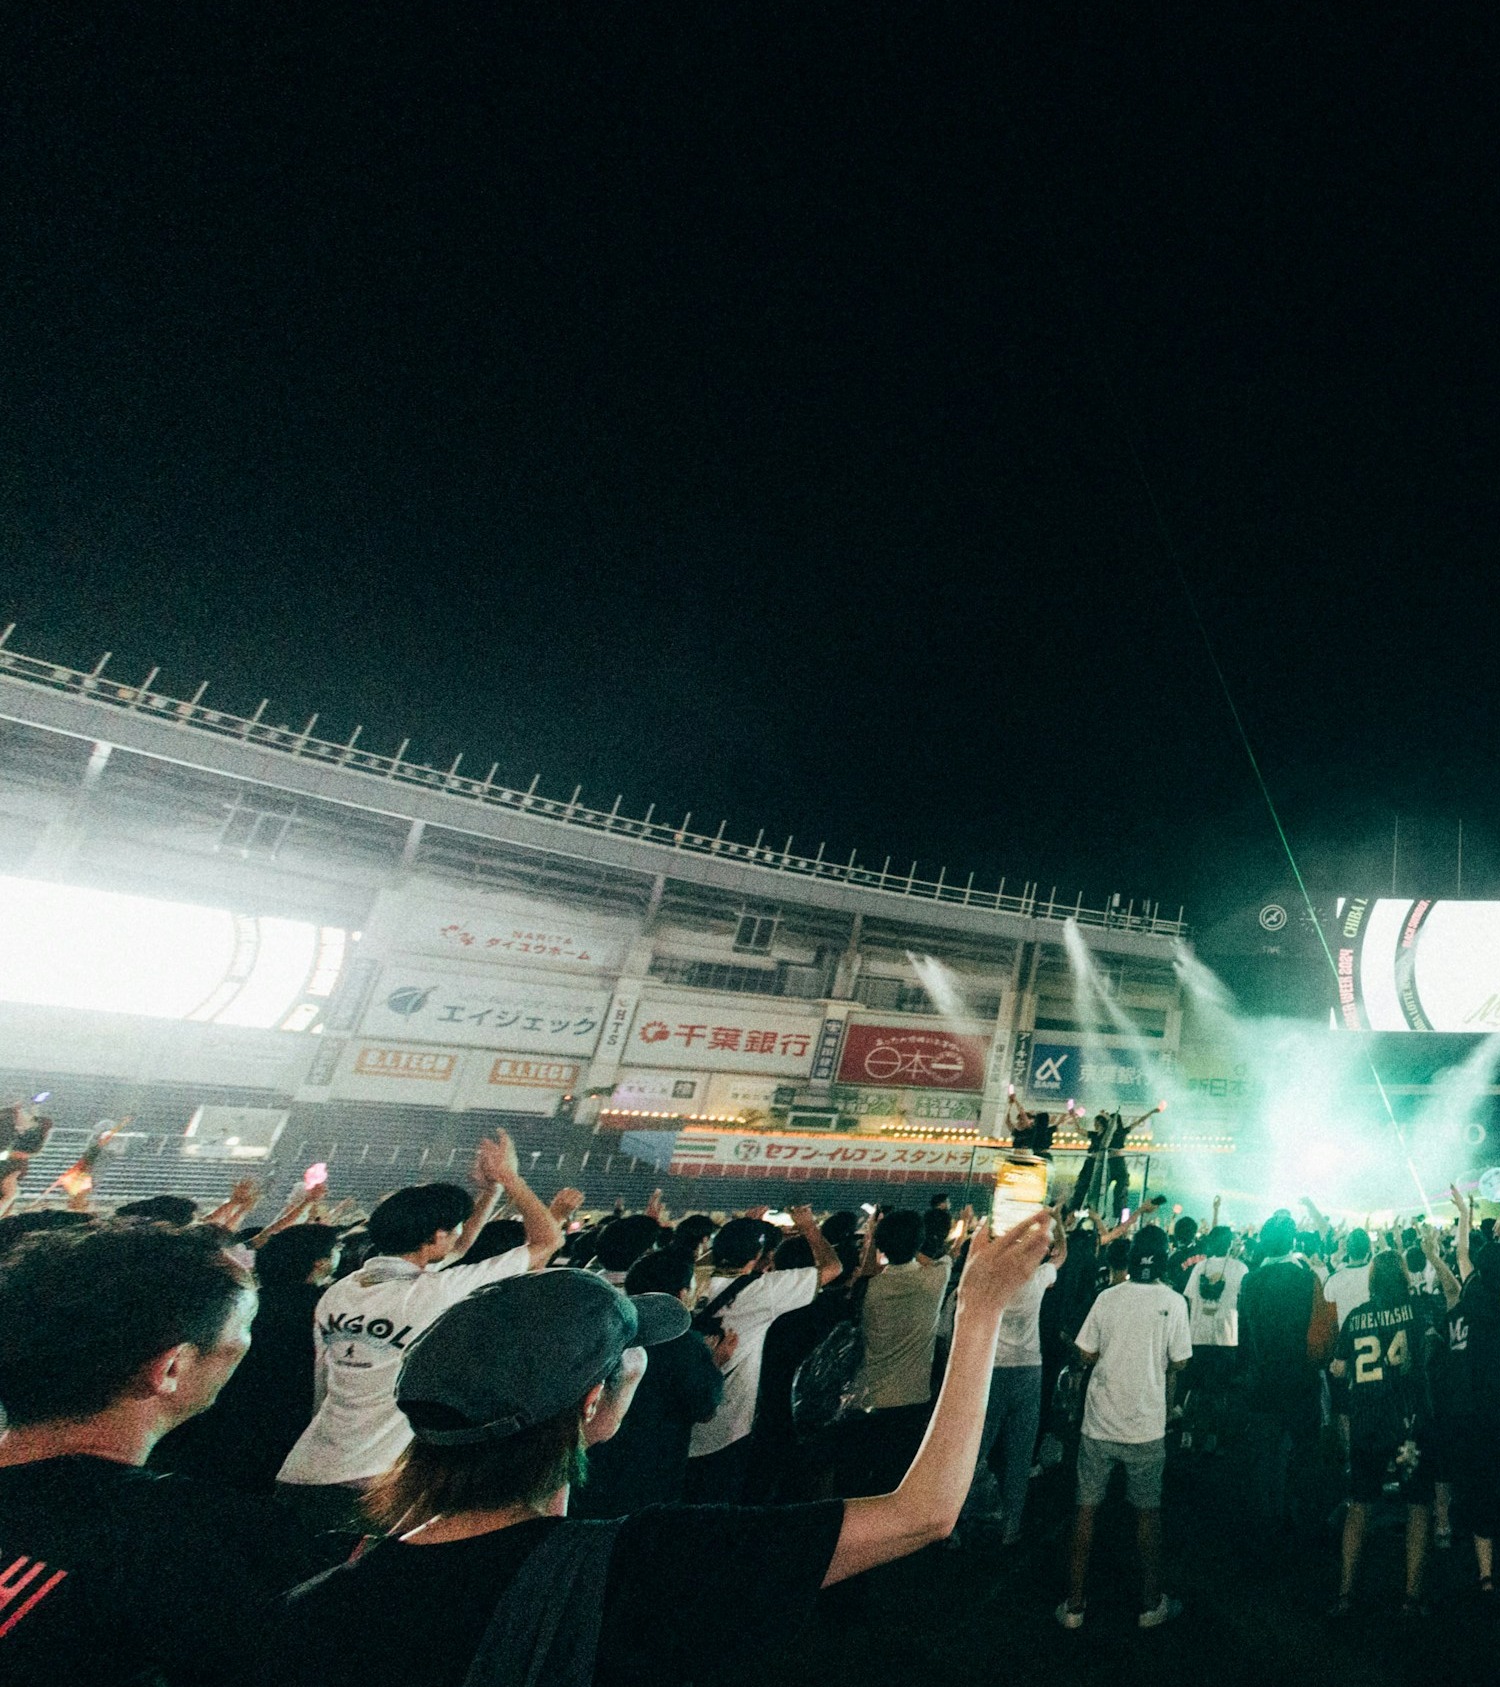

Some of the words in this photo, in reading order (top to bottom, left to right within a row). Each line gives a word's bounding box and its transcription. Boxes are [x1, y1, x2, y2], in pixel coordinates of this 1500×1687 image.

[674, 1023, 811, 1057] 千葉銀行
[1354, 1329, 1410, 1384] 24
